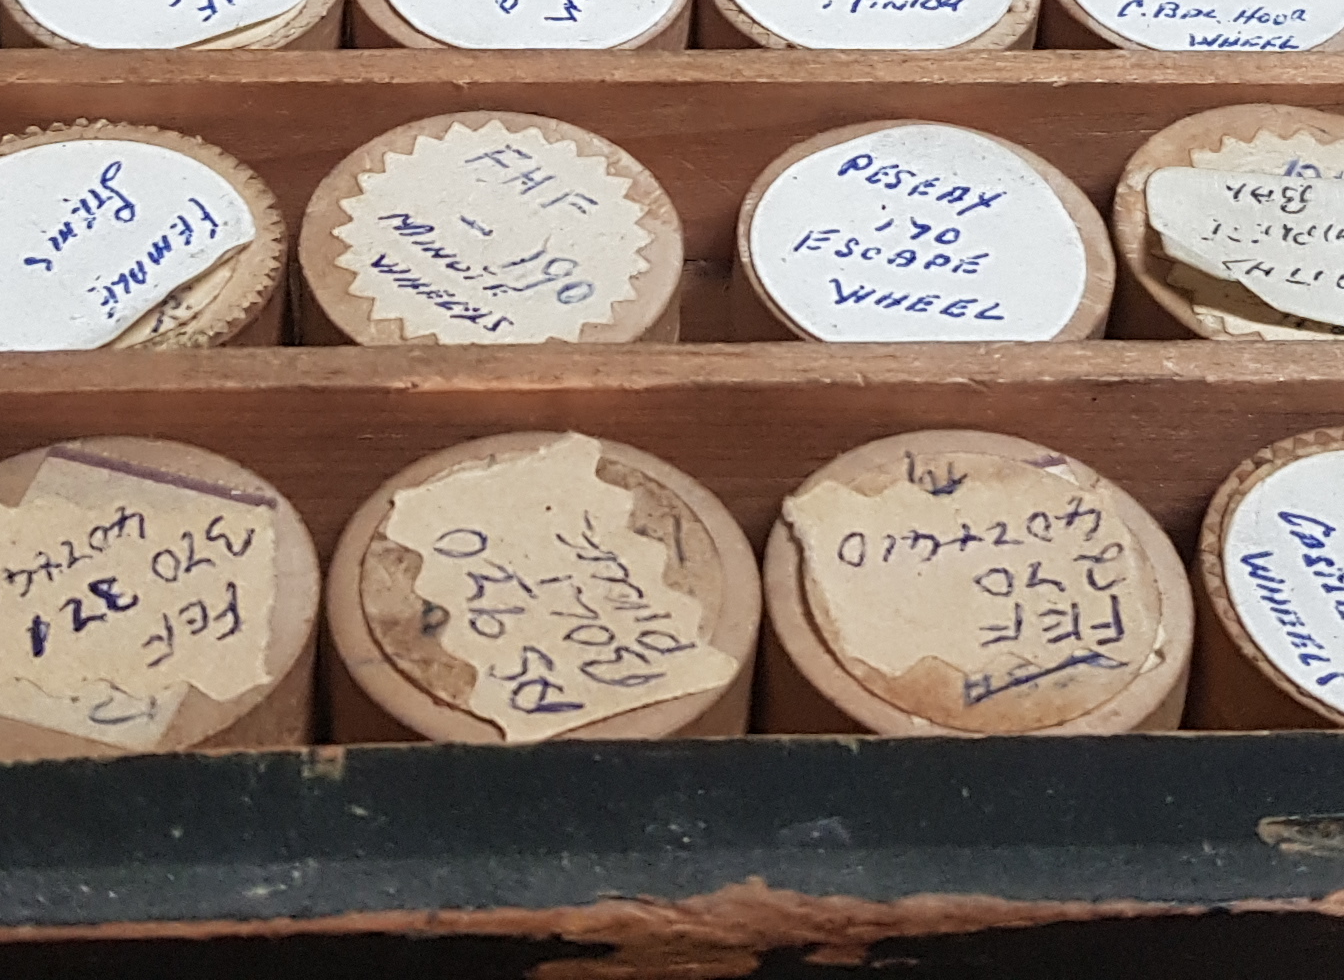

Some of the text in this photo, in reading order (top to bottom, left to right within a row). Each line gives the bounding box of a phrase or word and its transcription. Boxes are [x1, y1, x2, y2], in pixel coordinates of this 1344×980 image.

[1189, 32, 1300, 50] WHEEL
[464, 144, 599, 215] FHF
[793, 229, 990, 274] ESCAPE
[829, 278, 1005, 321] WHEEL
[979, 593, 1125, 647] FEF
